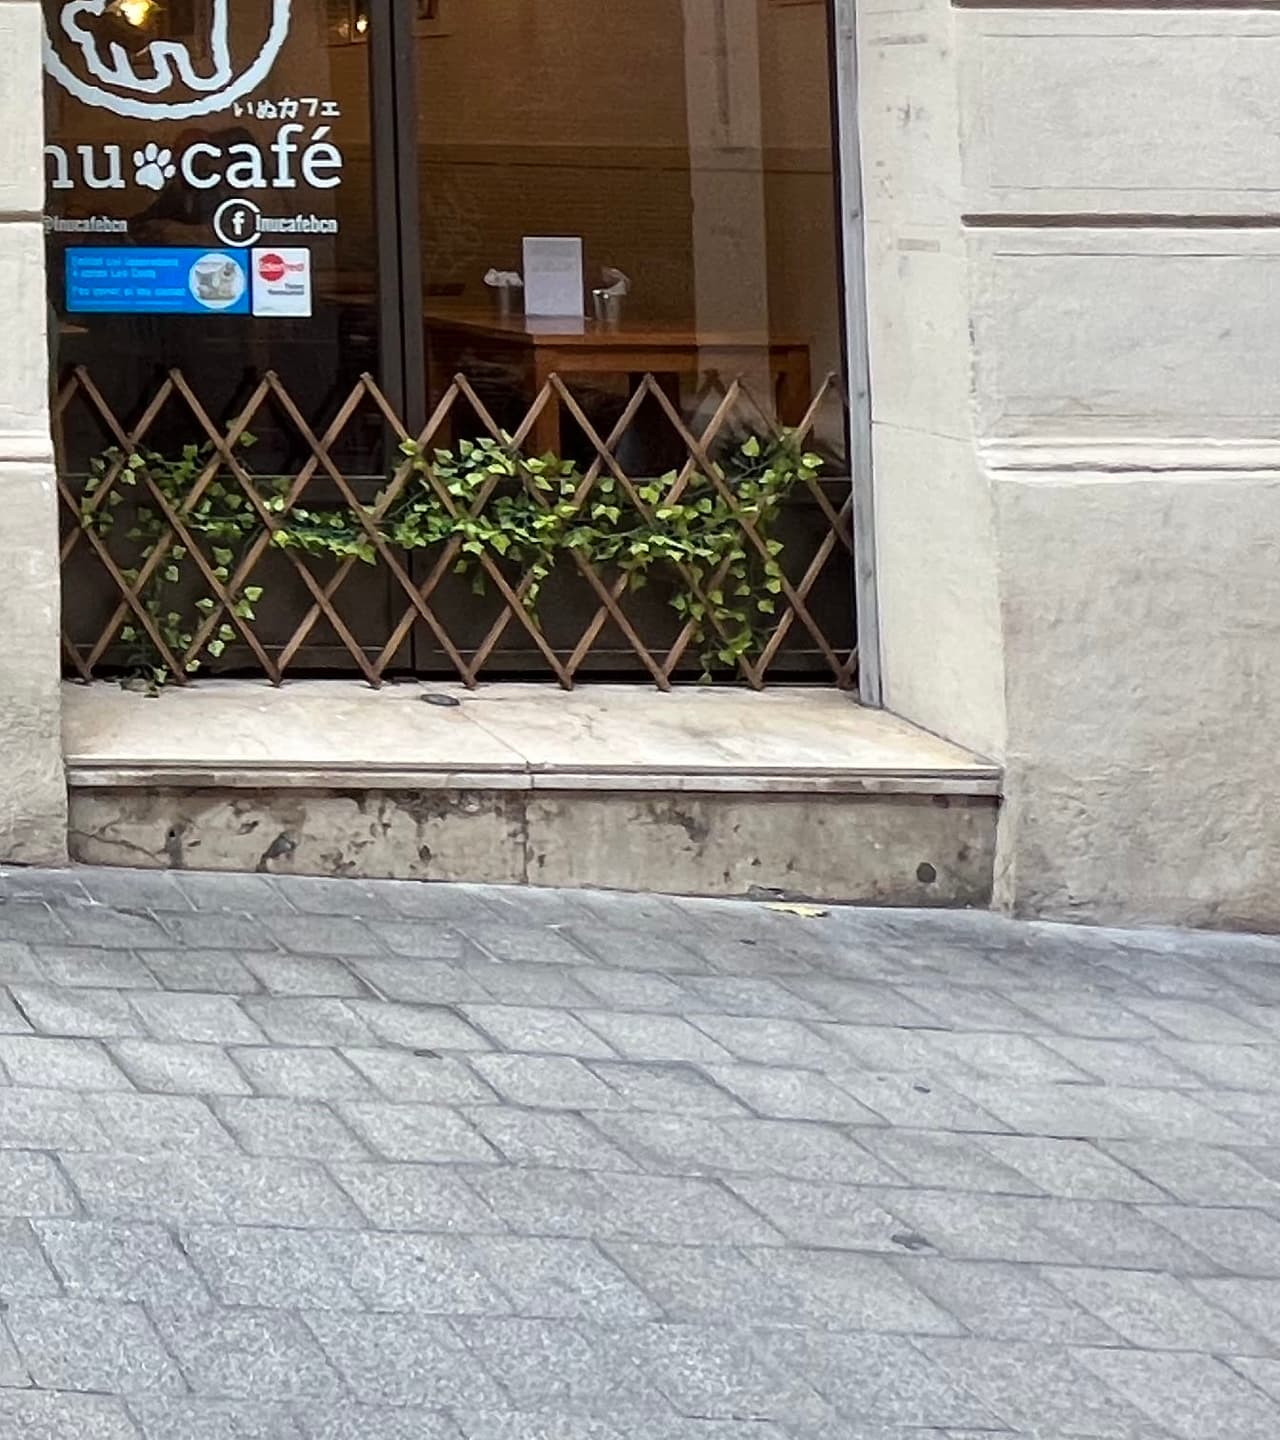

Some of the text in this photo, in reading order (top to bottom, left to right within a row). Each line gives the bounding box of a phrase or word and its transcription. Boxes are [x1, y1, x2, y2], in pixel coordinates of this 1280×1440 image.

[234, 97, 340, 119] いぬカフェ
[181, 124, 342, 189] café
